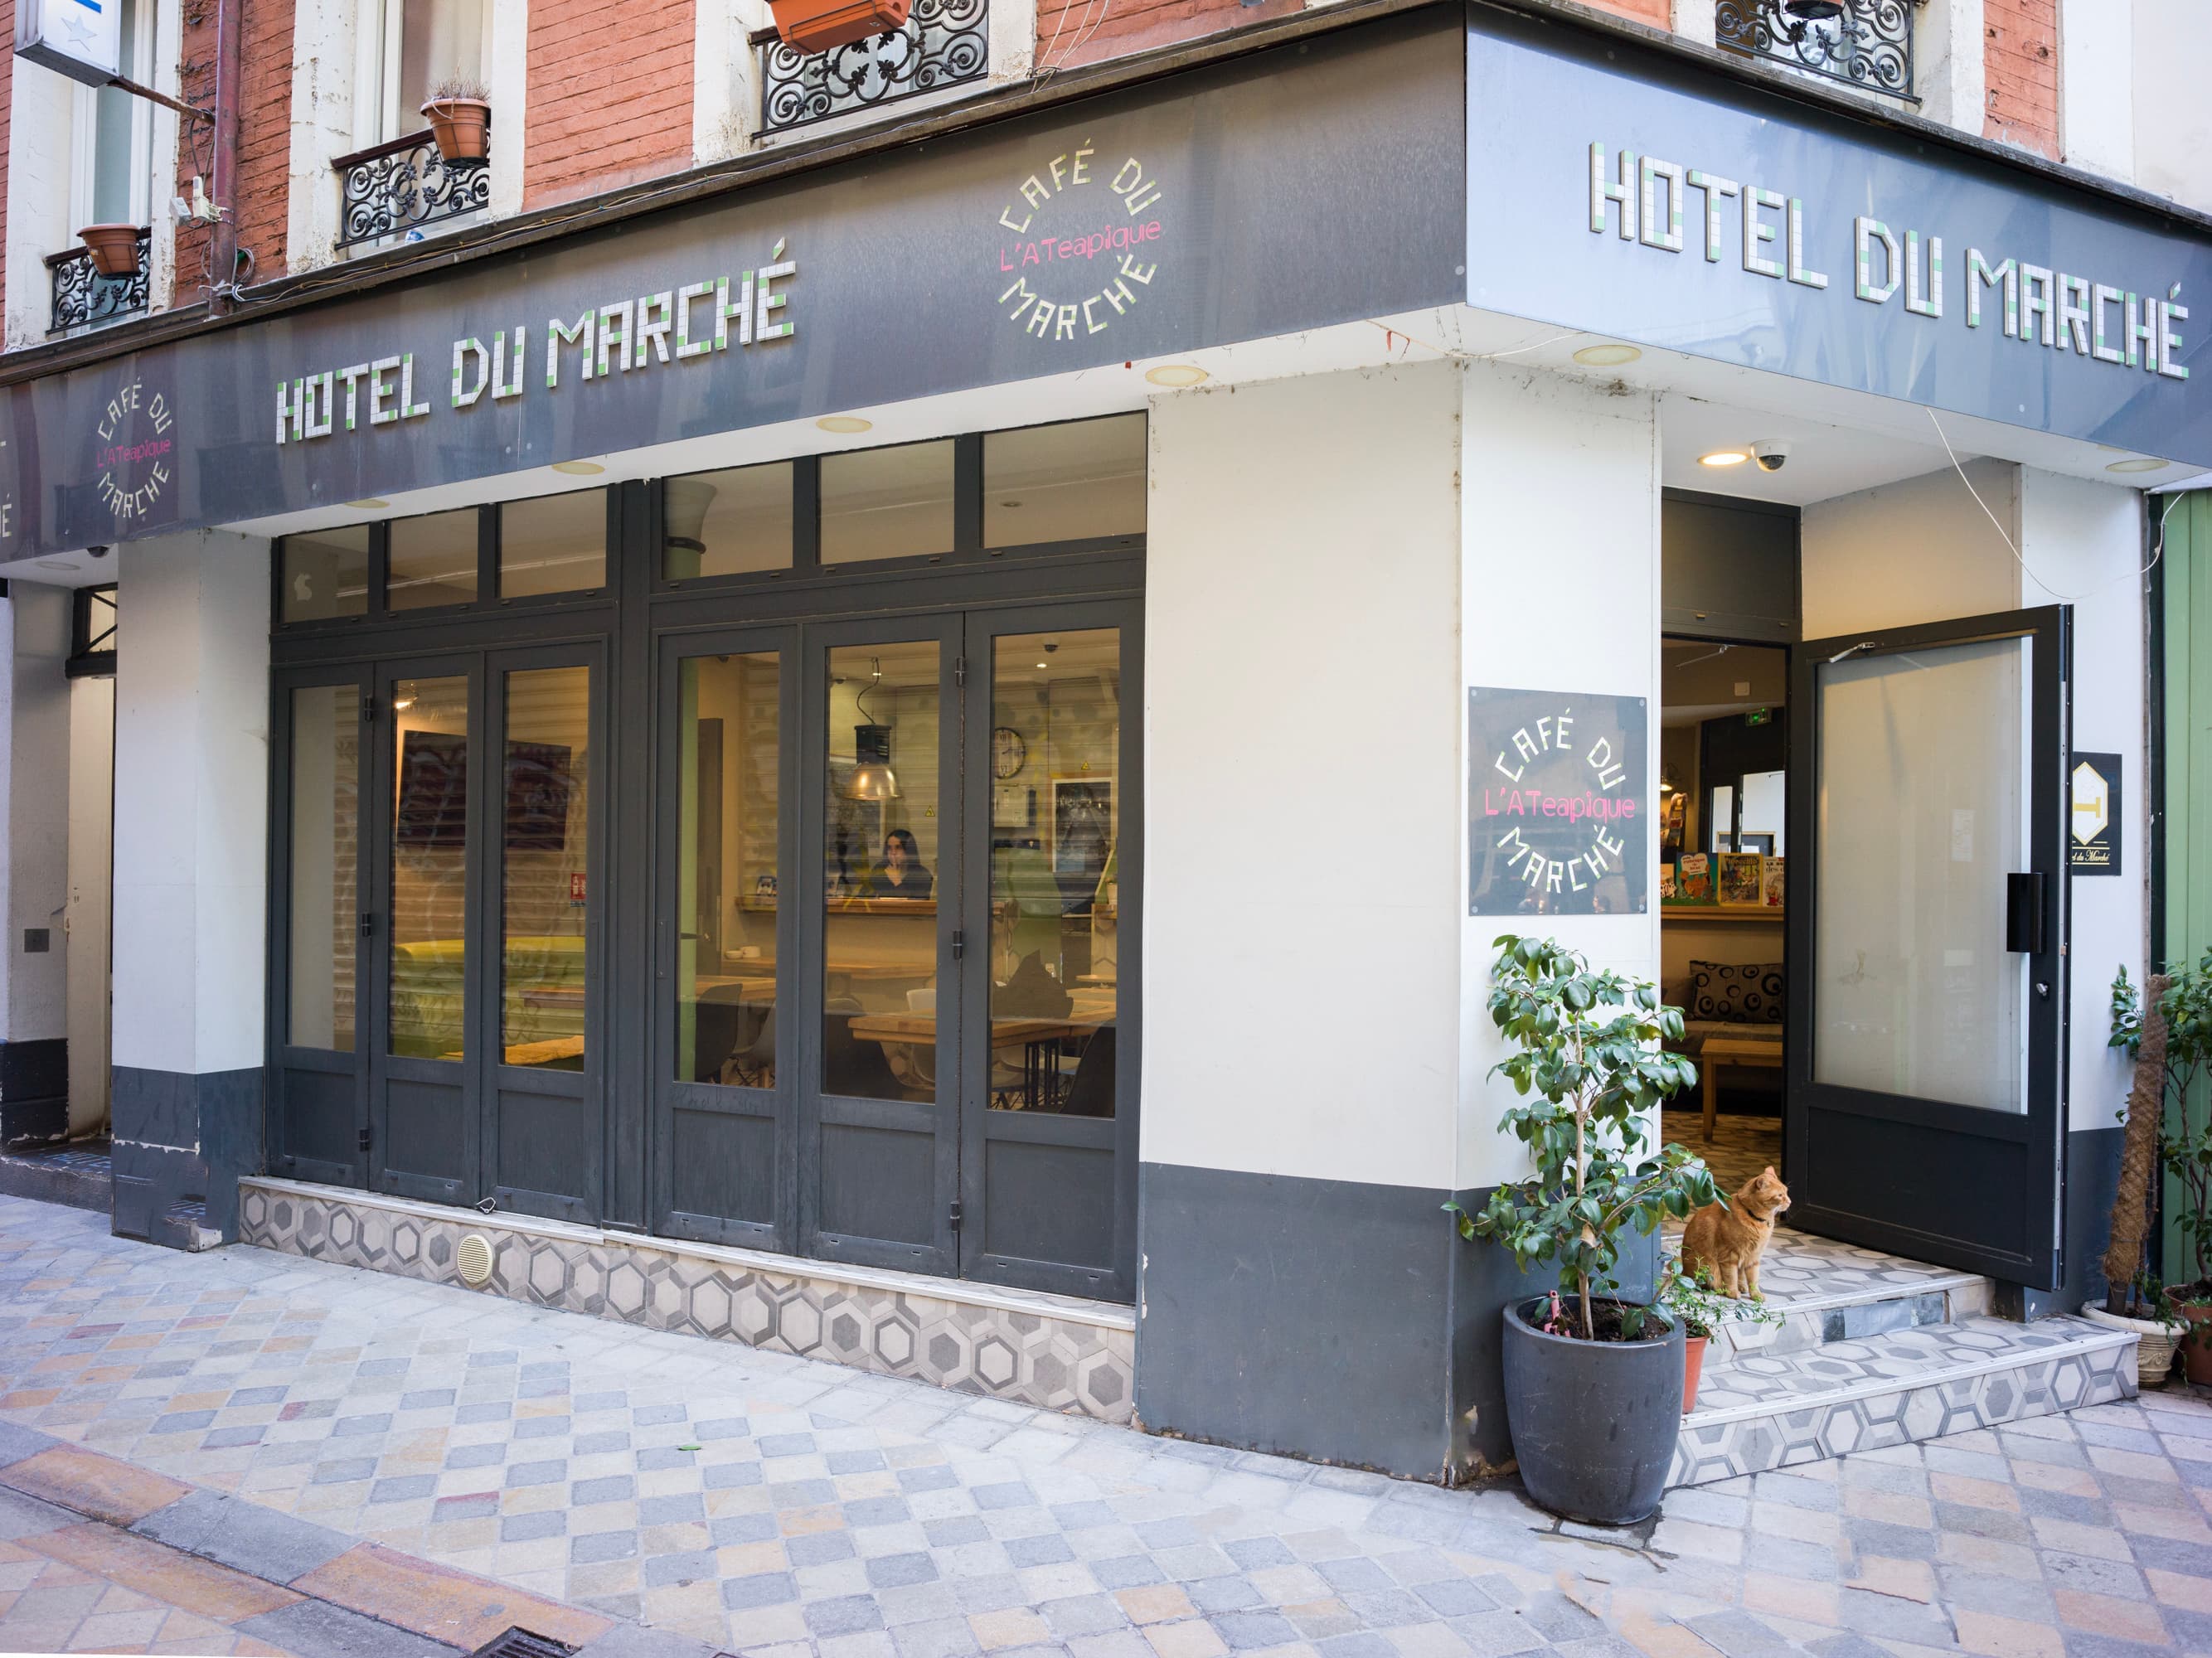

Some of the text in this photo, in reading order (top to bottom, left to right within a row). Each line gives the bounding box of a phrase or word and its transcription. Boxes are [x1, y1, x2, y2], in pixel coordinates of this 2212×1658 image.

[999, 138, 1162, 233] CAFÉ DU
[1590, 141, 2189, 380] HOTEL DU MARCHÉ
[276, 237, 796, 444] HOTEL DU MARCHÉ
[98, 376, 172, 441] CAFÉ DU
[1495, 707, 1626, 790] CAFÉ DU
[1496, 825, 1625, 894] MARCHÉ
